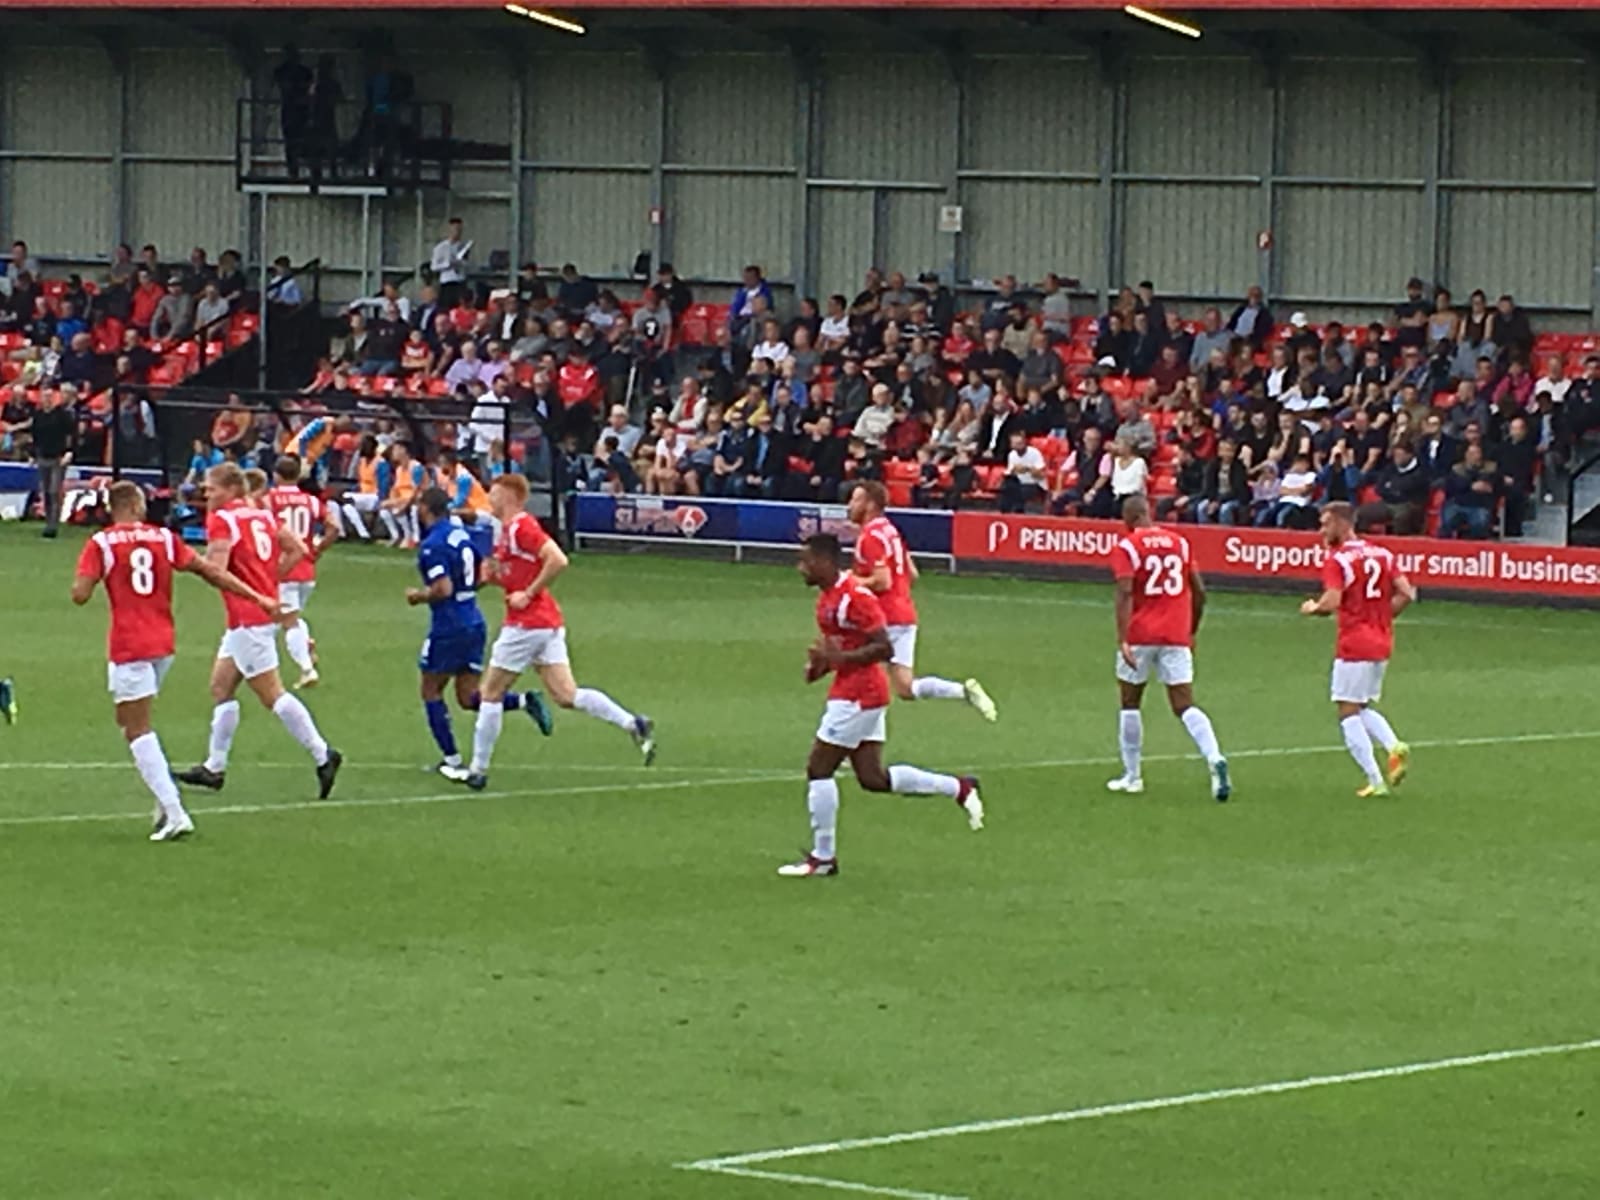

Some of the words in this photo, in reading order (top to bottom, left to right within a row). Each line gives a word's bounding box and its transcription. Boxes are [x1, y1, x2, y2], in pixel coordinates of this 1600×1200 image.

[251, 519, 272, 561] 6
[279, 506, 310, 540] 10
[130, 547, 154, 595] 8
[1145, 554, 1183, 595] 23
[1225, 537, 1324, 572] Support
[1427, 551, 1494, 577] small
[1364, 558, 1381, 598] 2
